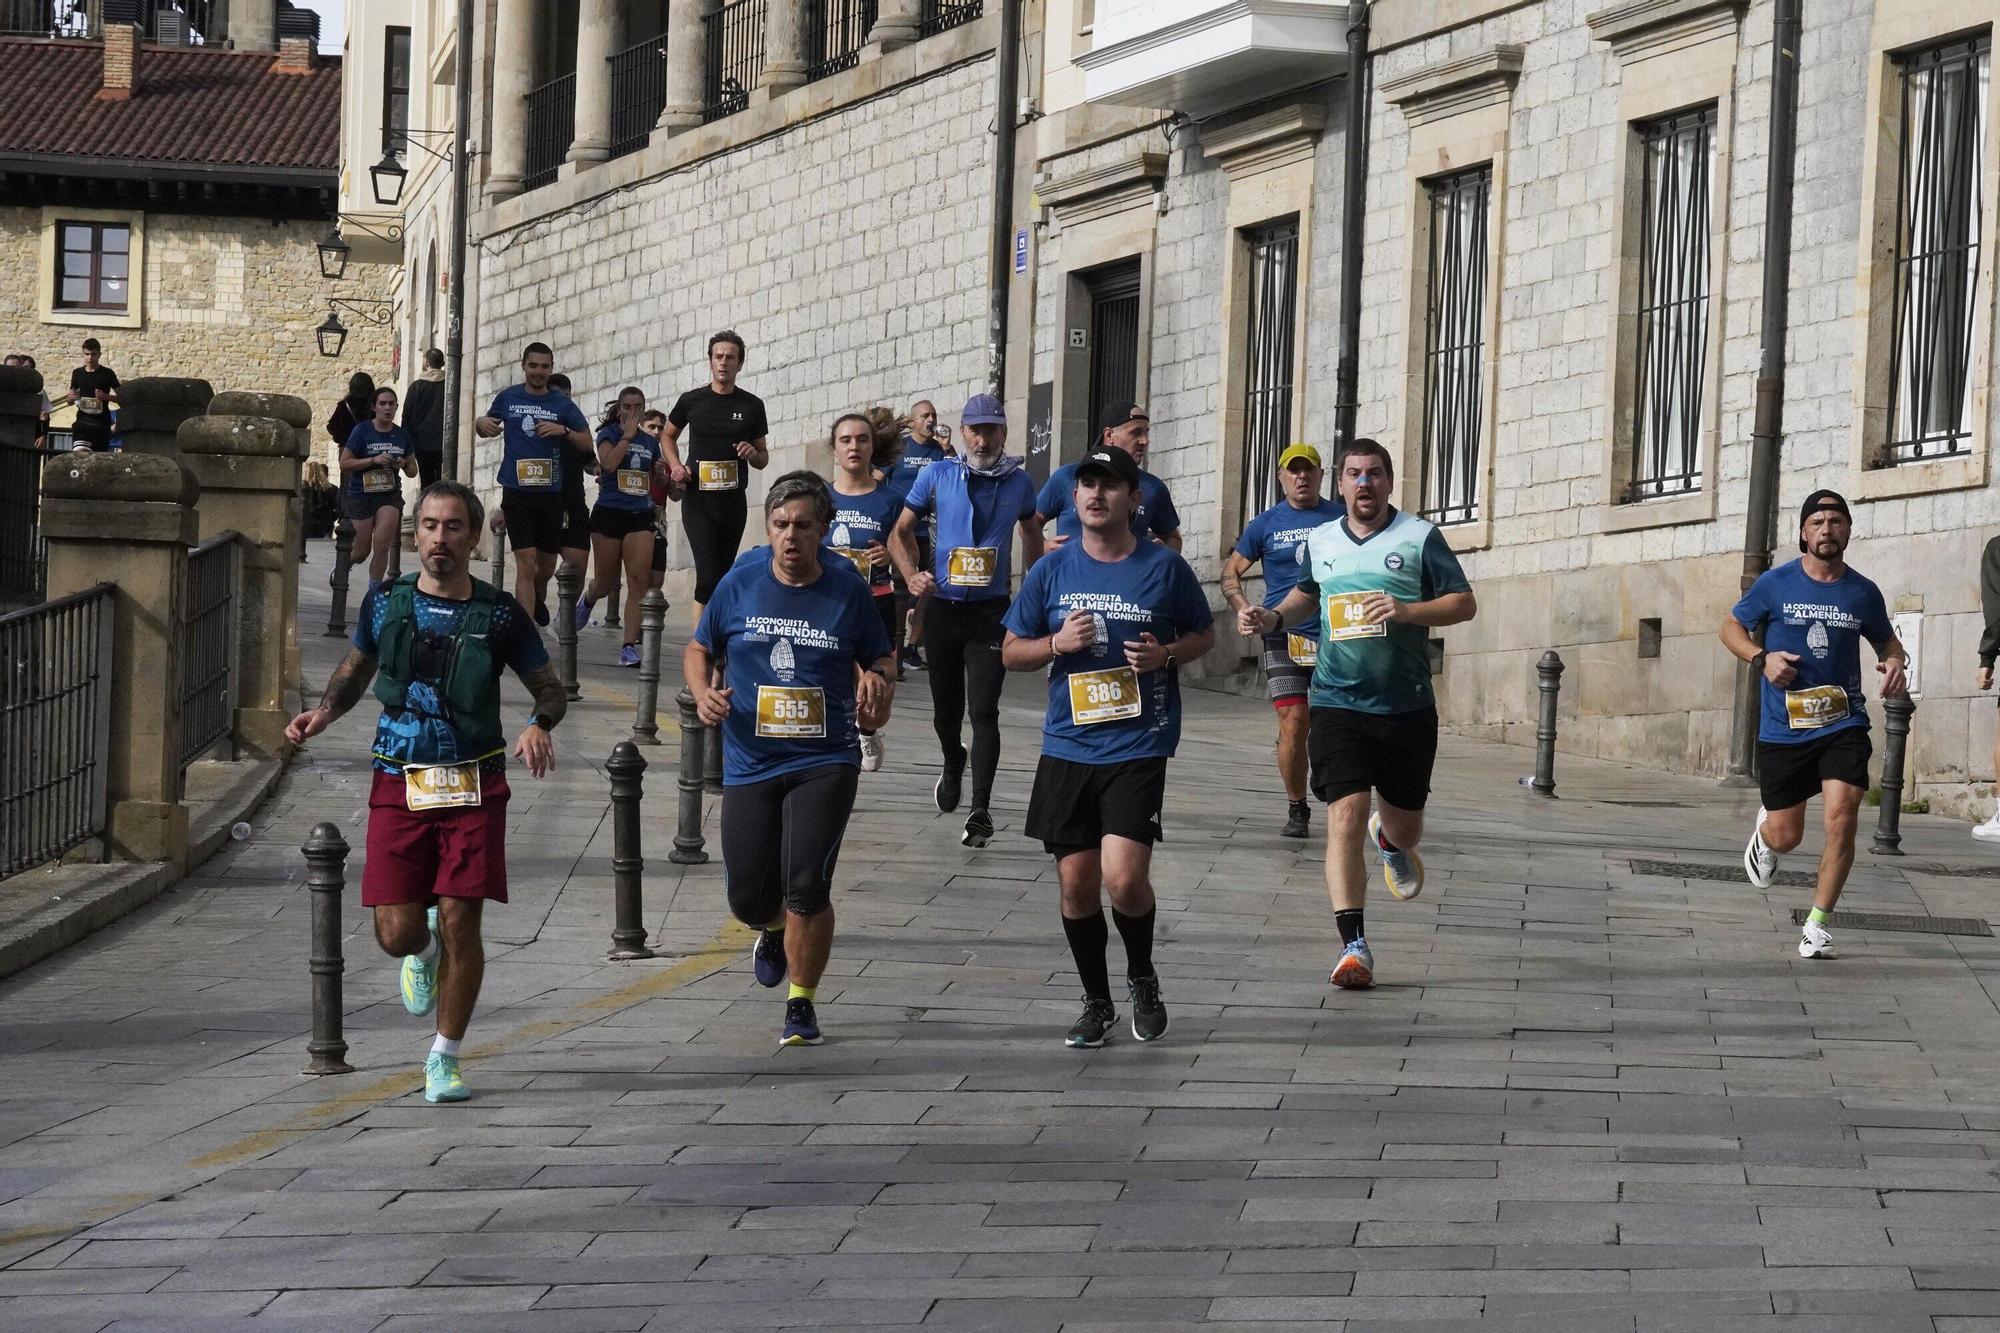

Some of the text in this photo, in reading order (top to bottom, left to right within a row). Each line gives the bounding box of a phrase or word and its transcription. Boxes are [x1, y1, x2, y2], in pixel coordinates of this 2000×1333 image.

[527, 465, 543, 476] 373
[711, 468, 727, 480] 611
[626, 476, 642, 487] 628
[1284, 533, 1309, 543] ALME
[961, 557, 985, 572] 123
[1060, 593, 1122, 602] LA CONQUISTA
[1070, 600, 1140, 614] ALMENDRA
[1792, 603, 1840, 613] CONQUISTA
[1106, 611, 1152, 623] KONKISTA
[1794, 609, 1854, 622] ALMENDRA
[746, 616, 810, 629] LA CONQUISTA
[757, 625, 828, 640] ALMENDRA
[794, 637, 839, 650] KONKISTA
[1087, 681, 1122, 704] 386
[774, 699, 809, 719] 555
[1802, 696, 1832, 714] 522
[424, 766, 460, 787] 486
